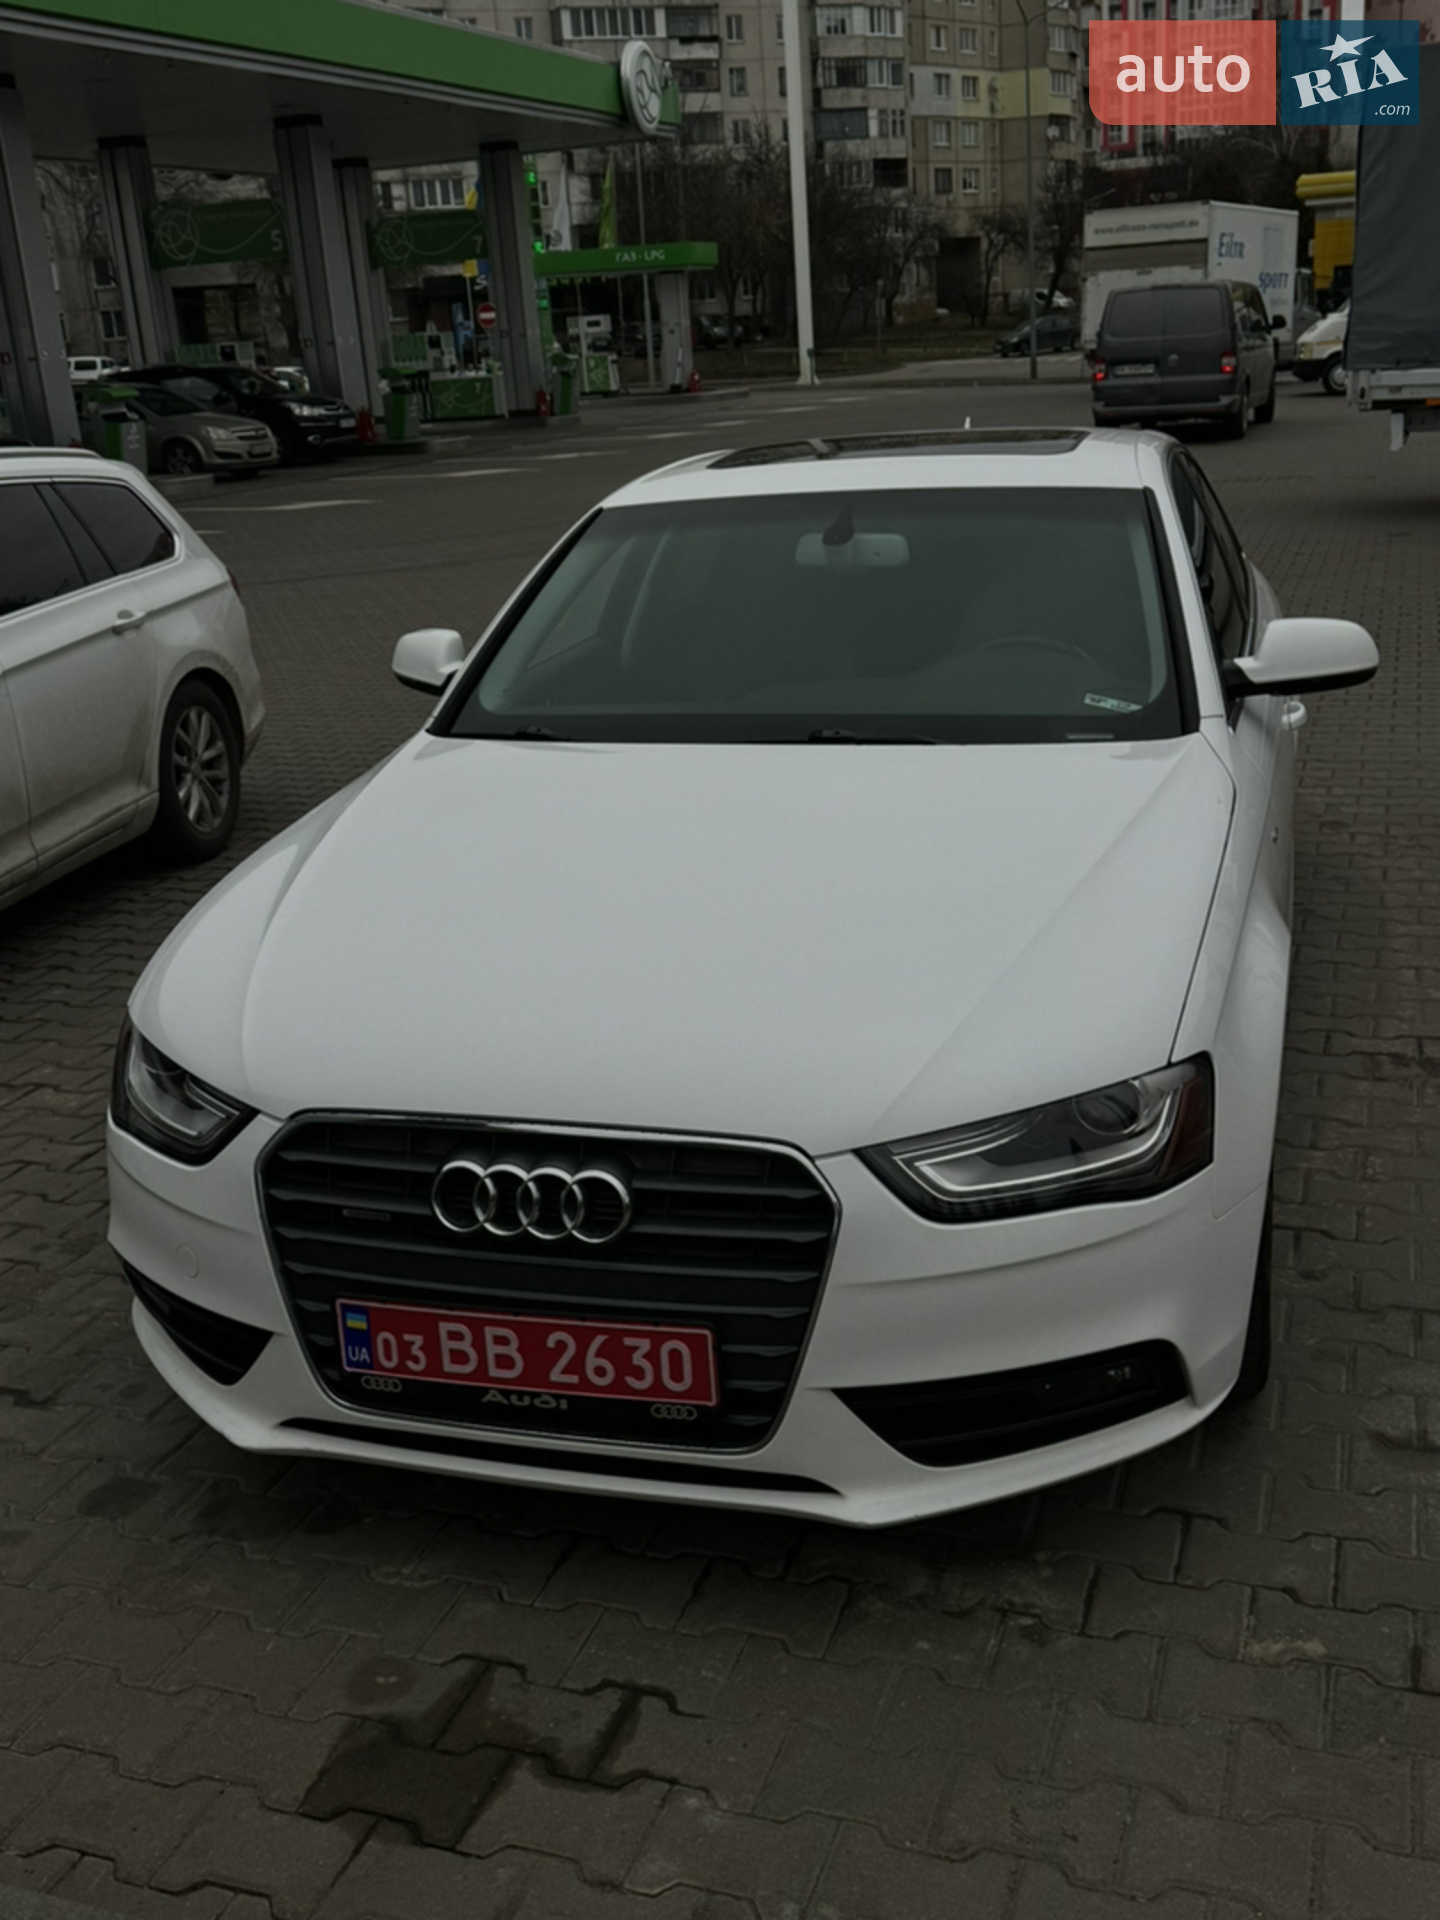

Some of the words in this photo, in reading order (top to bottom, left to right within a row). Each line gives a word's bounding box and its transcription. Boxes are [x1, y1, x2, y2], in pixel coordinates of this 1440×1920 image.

[270, 229, 284, 252] 5
[472, 235, 484, 254] 7
[347, 1346, 371, 1364] UA
[375, 1330, 428, 1373] 03
[437, 1320, 525, 1380] BB
[545, 1330, 693, 1393] 2630
